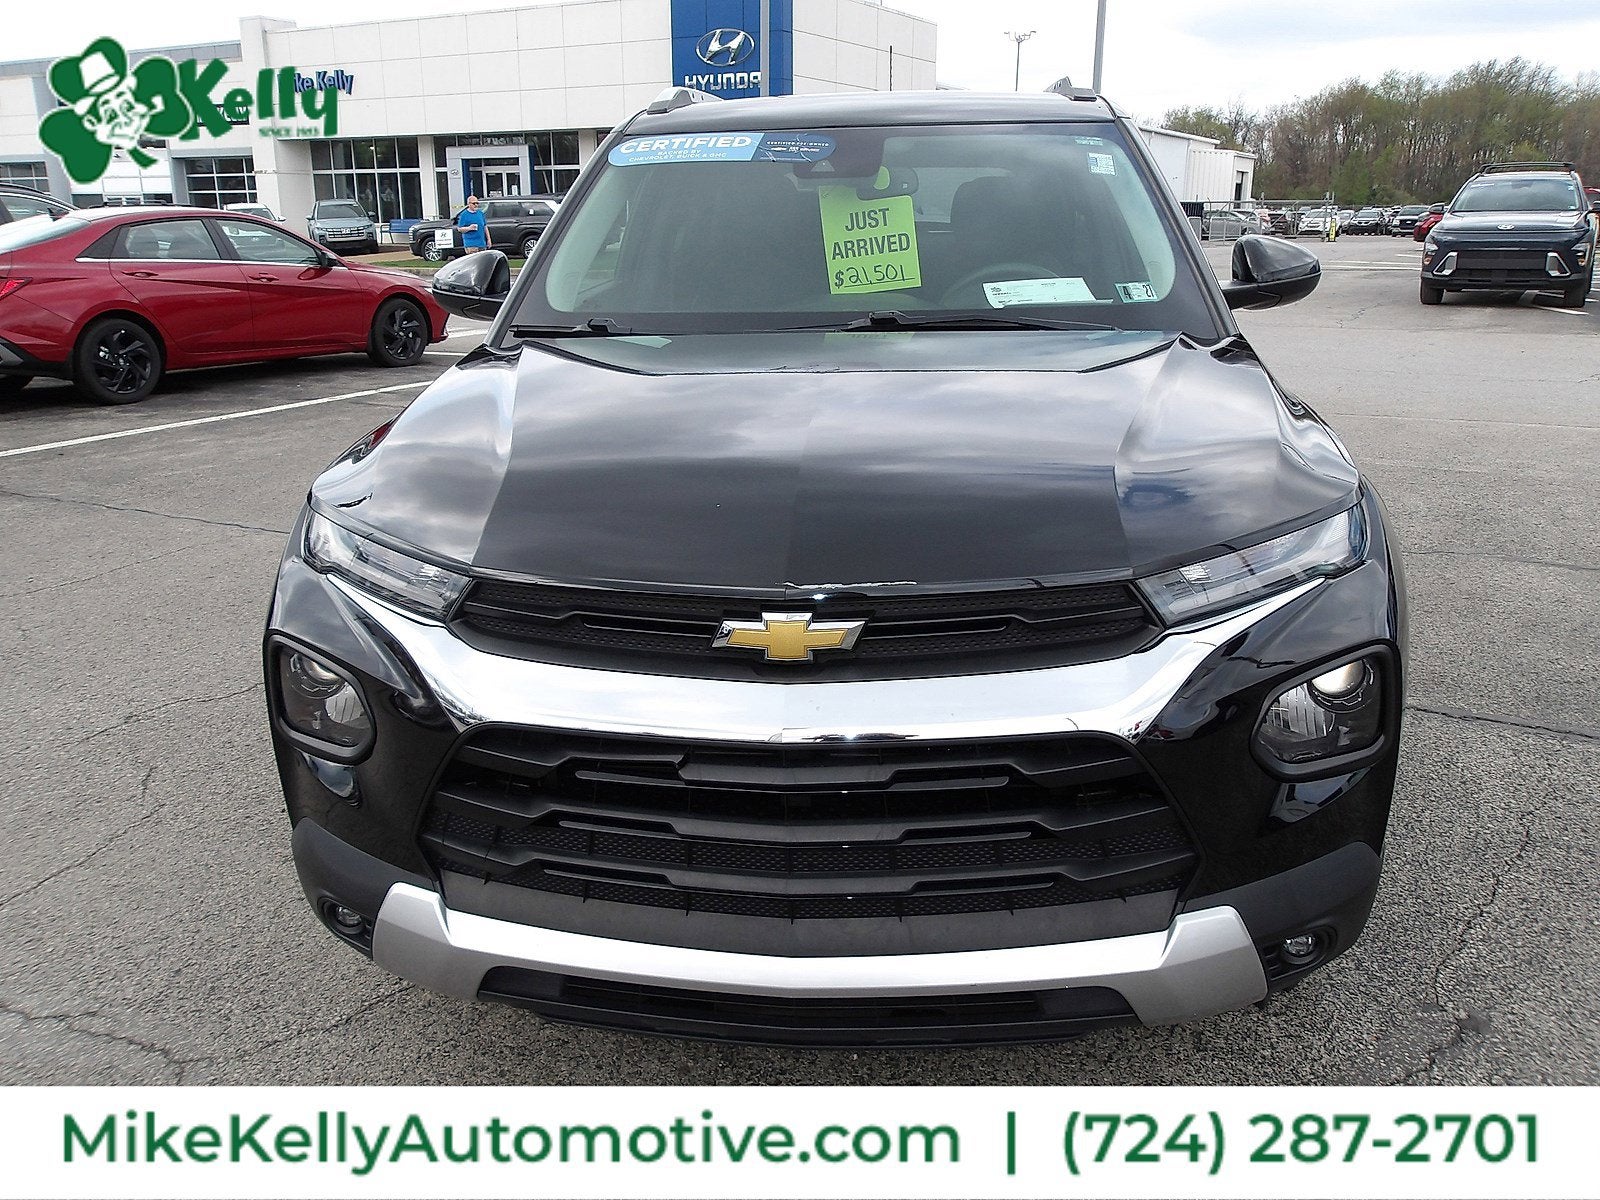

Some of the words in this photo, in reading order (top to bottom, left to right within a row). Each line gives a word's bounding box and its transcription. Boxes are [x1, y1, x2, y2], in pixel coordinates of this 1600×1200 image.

[316, 70, 354, 95] Kelly
[684, 71, 761, 90] HYUNDA
[620, 136, 752, 154] CERTIFIED
[845, 207, 890, 232] JUST
[831, 232, 911, 260] ARRIVED
